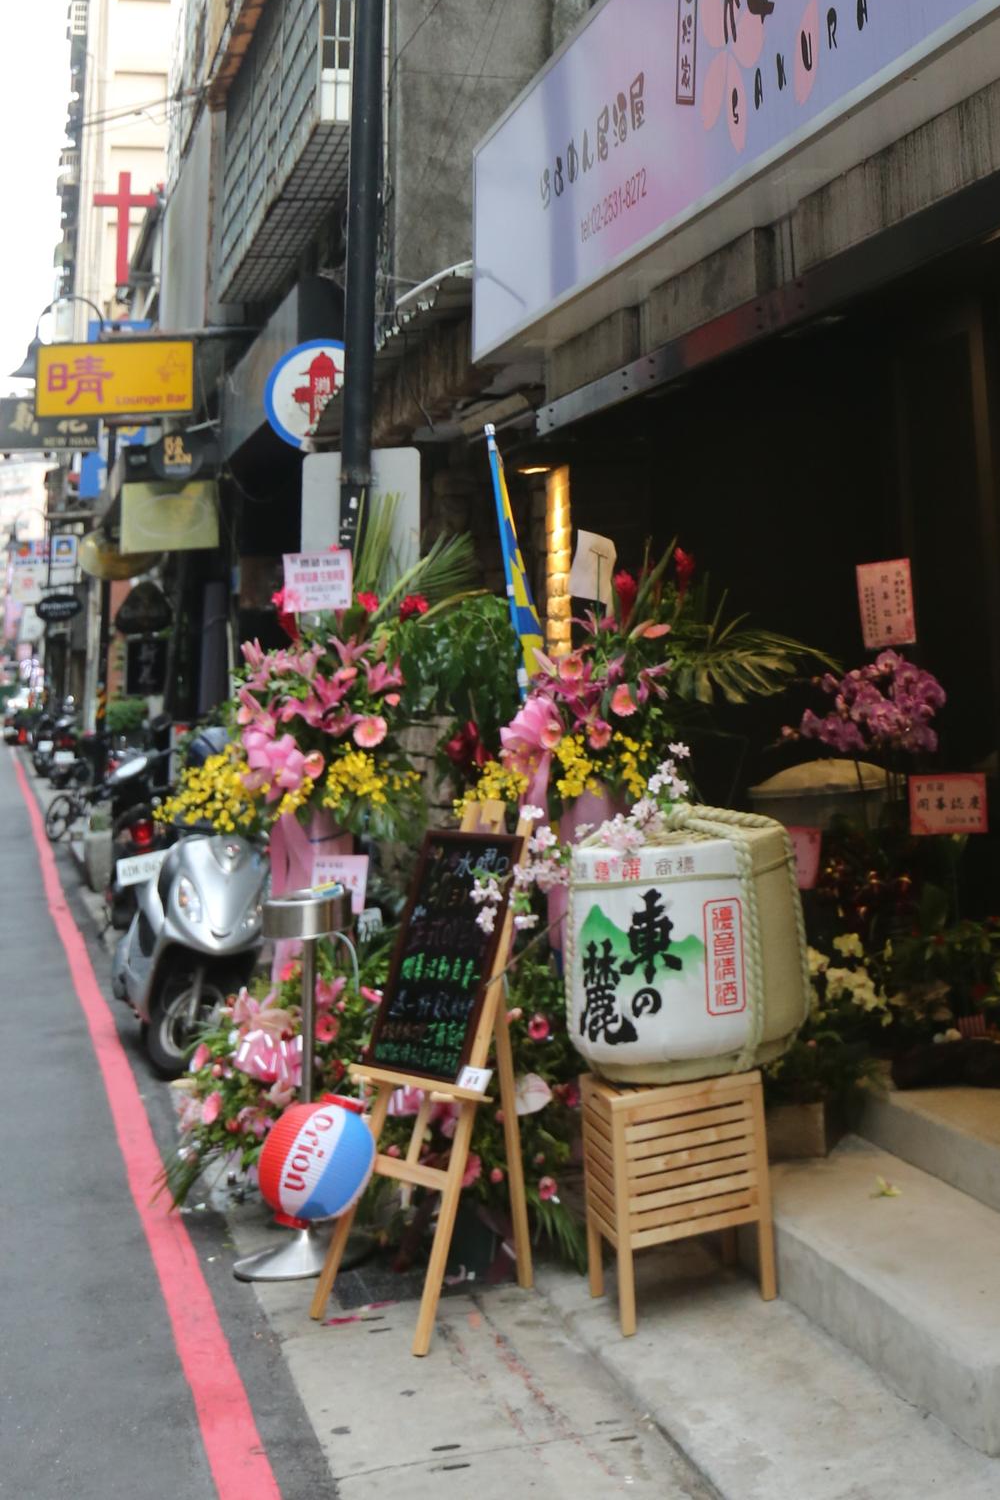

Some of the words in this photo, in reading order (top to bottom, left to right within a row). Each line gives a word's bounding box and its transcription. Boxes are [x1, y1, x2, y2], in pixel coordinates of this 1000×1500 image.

[48, 355, 113, 405] 晴
[167, 393, 187, 404] Bar
[284, 1113, 334, 1191] Orion
